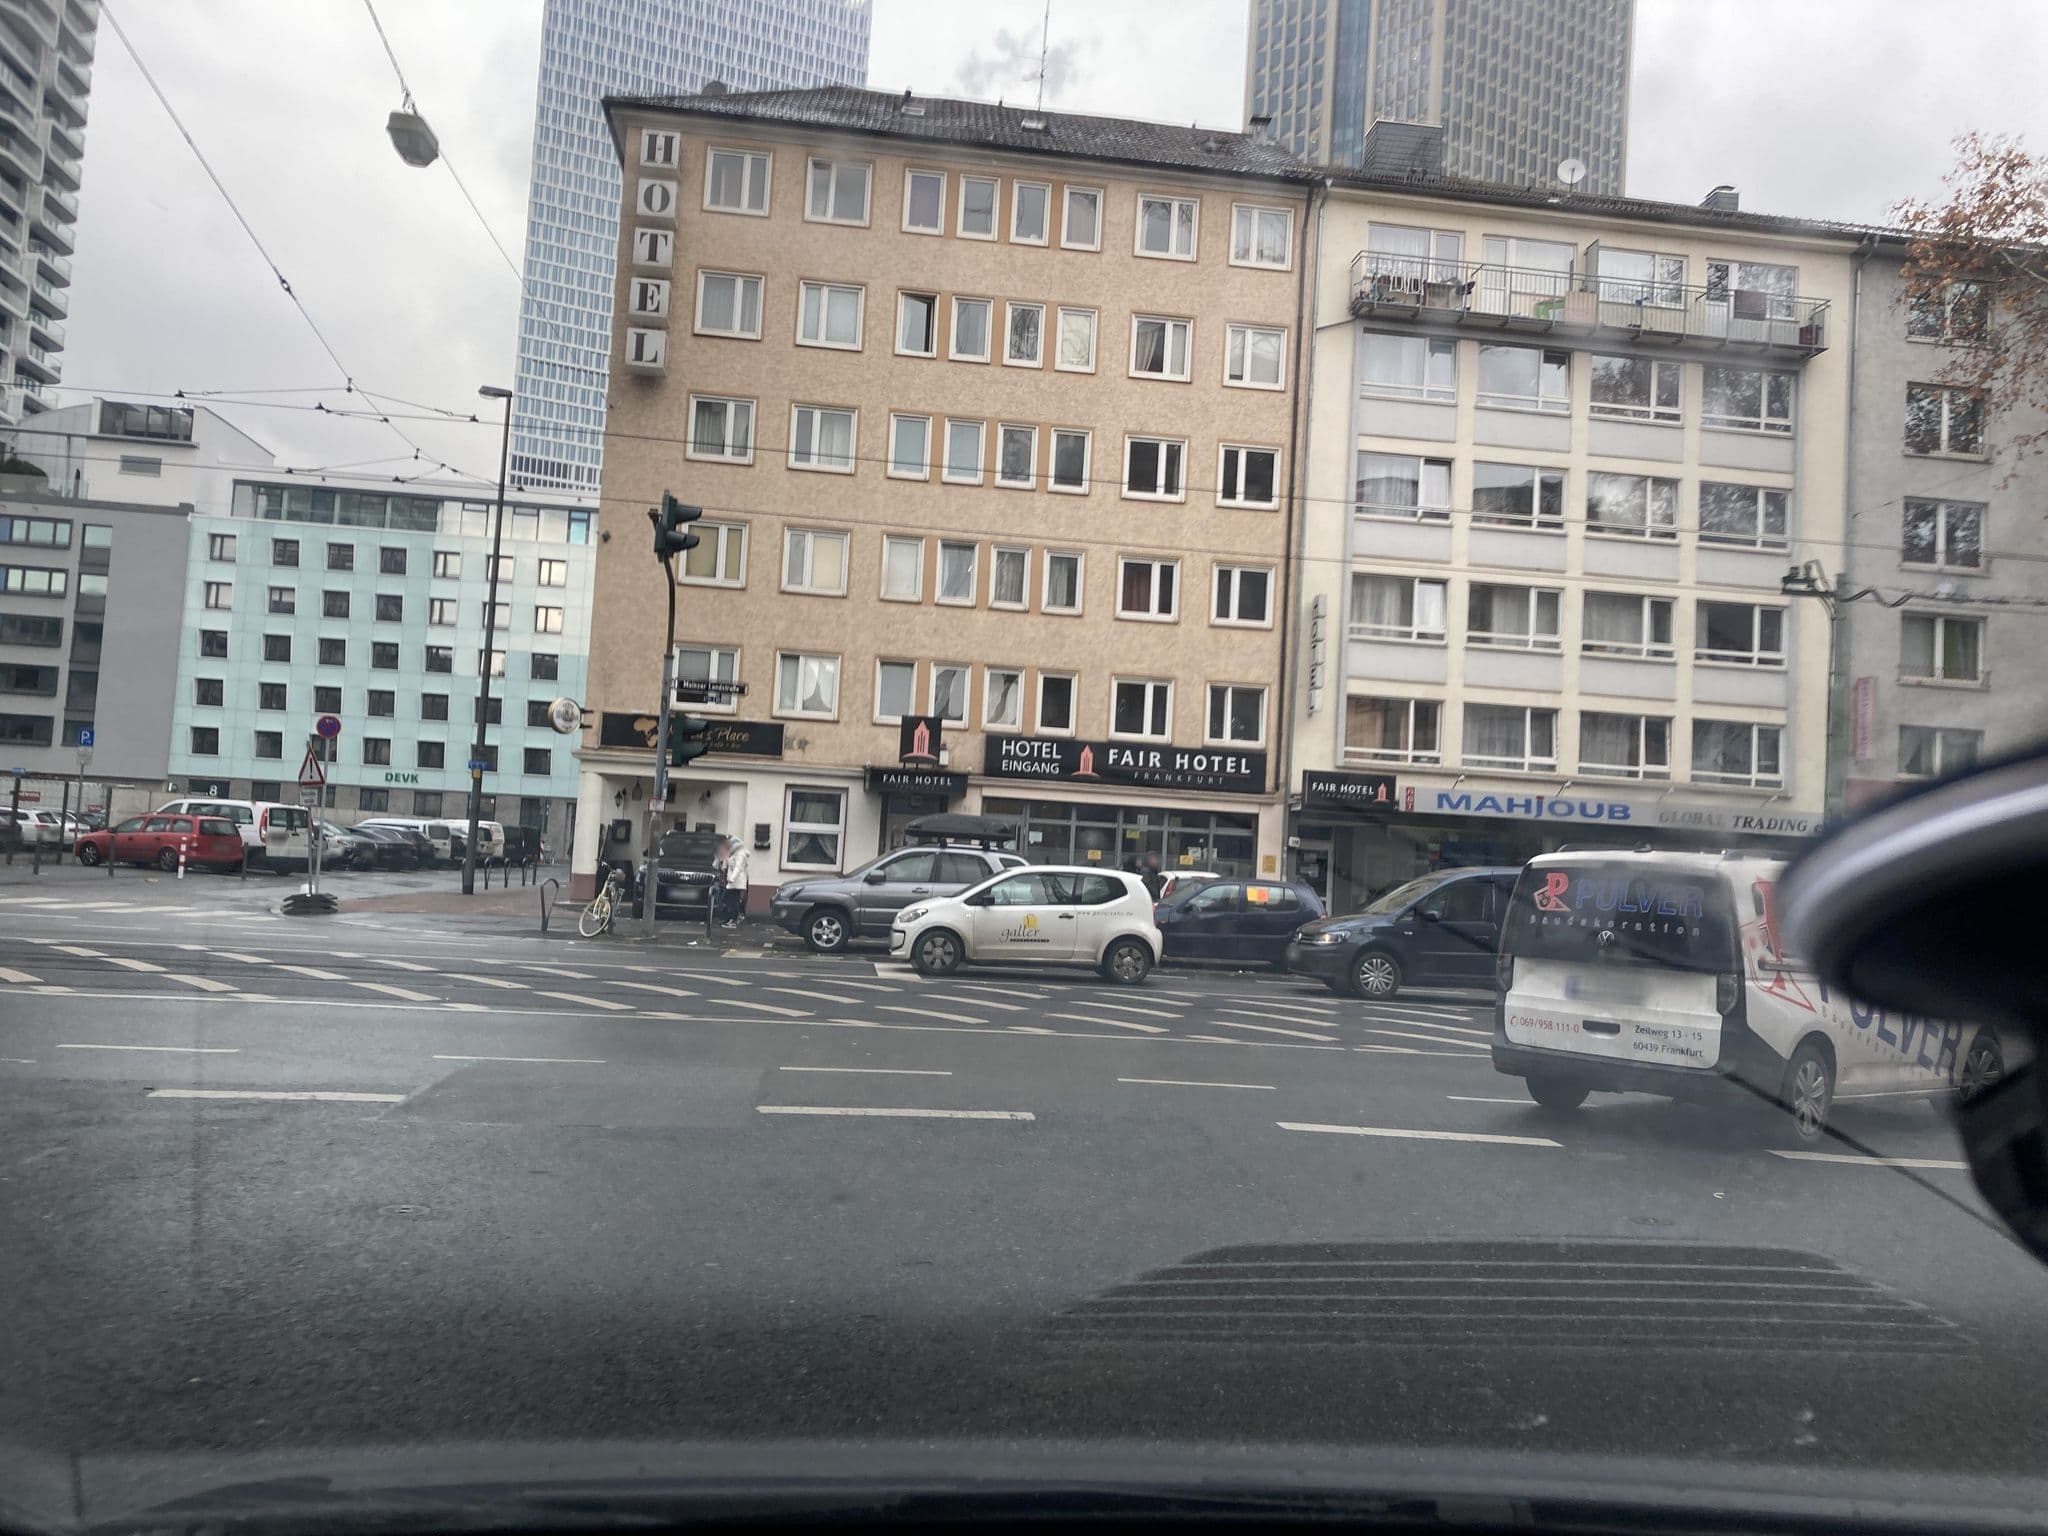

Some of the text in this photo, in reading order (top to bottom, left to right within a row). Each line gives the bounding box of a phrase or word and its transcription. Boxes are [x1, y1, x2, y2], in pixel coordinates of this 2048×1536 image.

[631, 133, 676, 363] HOTEL
[1001, 740, 1062, 759] HOTEL
[1001, 760, 1060, 774] EINGANG
[1108, 749, 1251, 774] FAIR HOTEL
[385, 772, 419, 783] DEVK
[882, 774, 952, 787] FAIR HOTEL
[1134, 771, 1223, 784] FRANKFURT
[1312, 782, 1374, 796] FAIR HOTEL
[1732, 815, 1809, 832] TRADING
[1575, 878, 1705, 918] PULVER
[1519, 1016, 1553, 1030] 069/958
[1634, 1024, 1669, 1039] Zeilweg
[1672, 1030, 1682, 1039] 13
[1692, 1032, 1702, 1041] 15
[1633, 1041, 1703, 1058] 60439 Frankfurt
